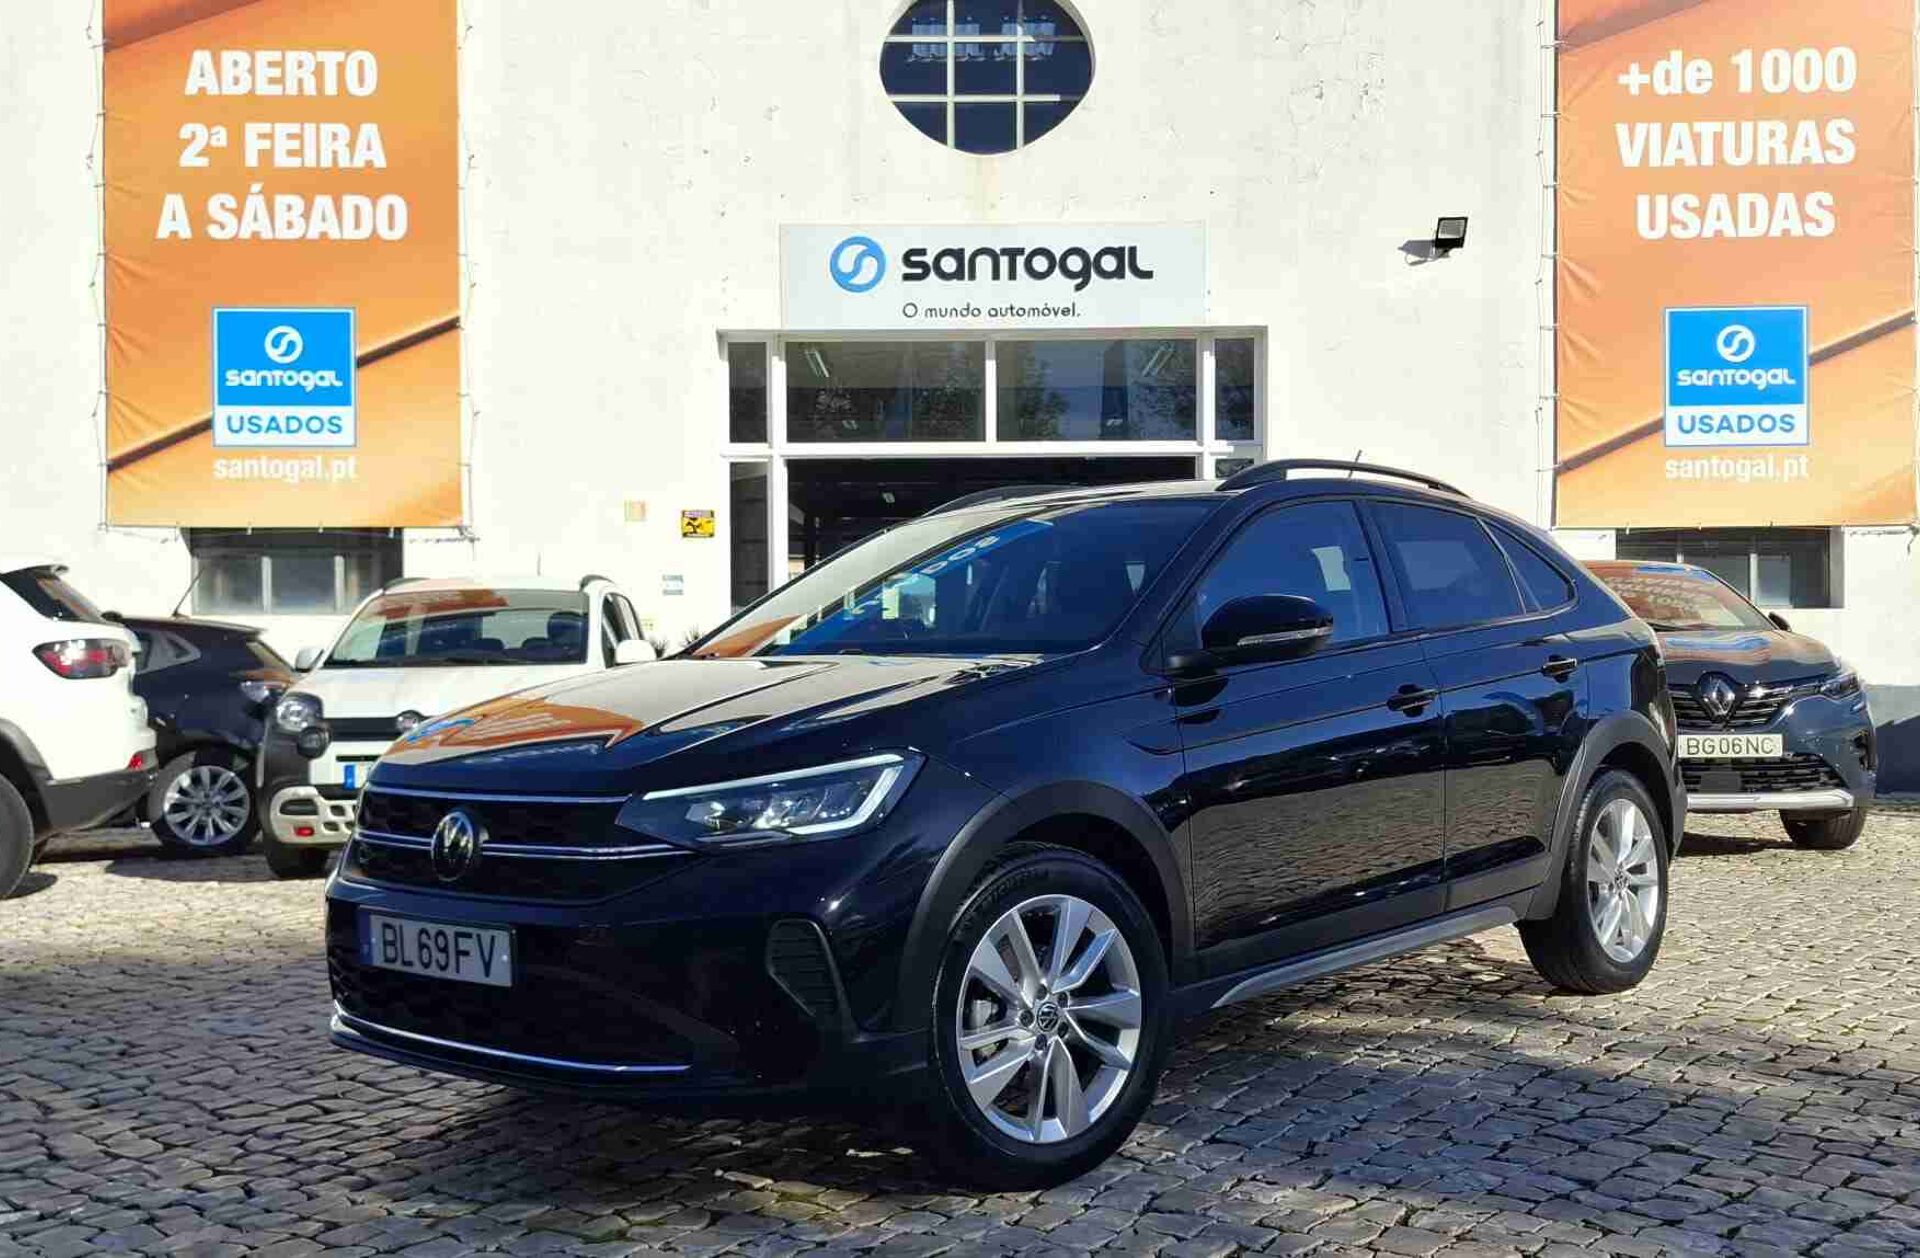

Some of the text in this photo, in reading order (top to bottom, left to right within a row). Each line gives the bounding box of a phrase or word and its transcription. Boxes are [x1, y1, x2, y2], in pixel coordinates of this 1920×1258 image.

[186, 50, 377, 97] ABERTO
[1732, 47, 1857, 93] 1000
[245, 123, 386, 167] FEIRA
[1616, 118, 1856, 167] VIATURAS
[157, 184, 408, 240] A SÁBADO
[1636, 192, 1835, 239] USADAS
[902, 246, 1154, 292] santogal
[902, 301, 1081, 318] O mundo automóvel.
[226, 369, 343, 391] santogal
[1677, 367, 1796, 391] santogal
[226, 415, 343, 435] USADOS
[1678, 414, 1795, 434] USADOS
[213, 455, 358, 482] santogal.pt
[1665, 454, 1810, 482] santogal.pt
[381, 922, 496, 978] BL69FV
